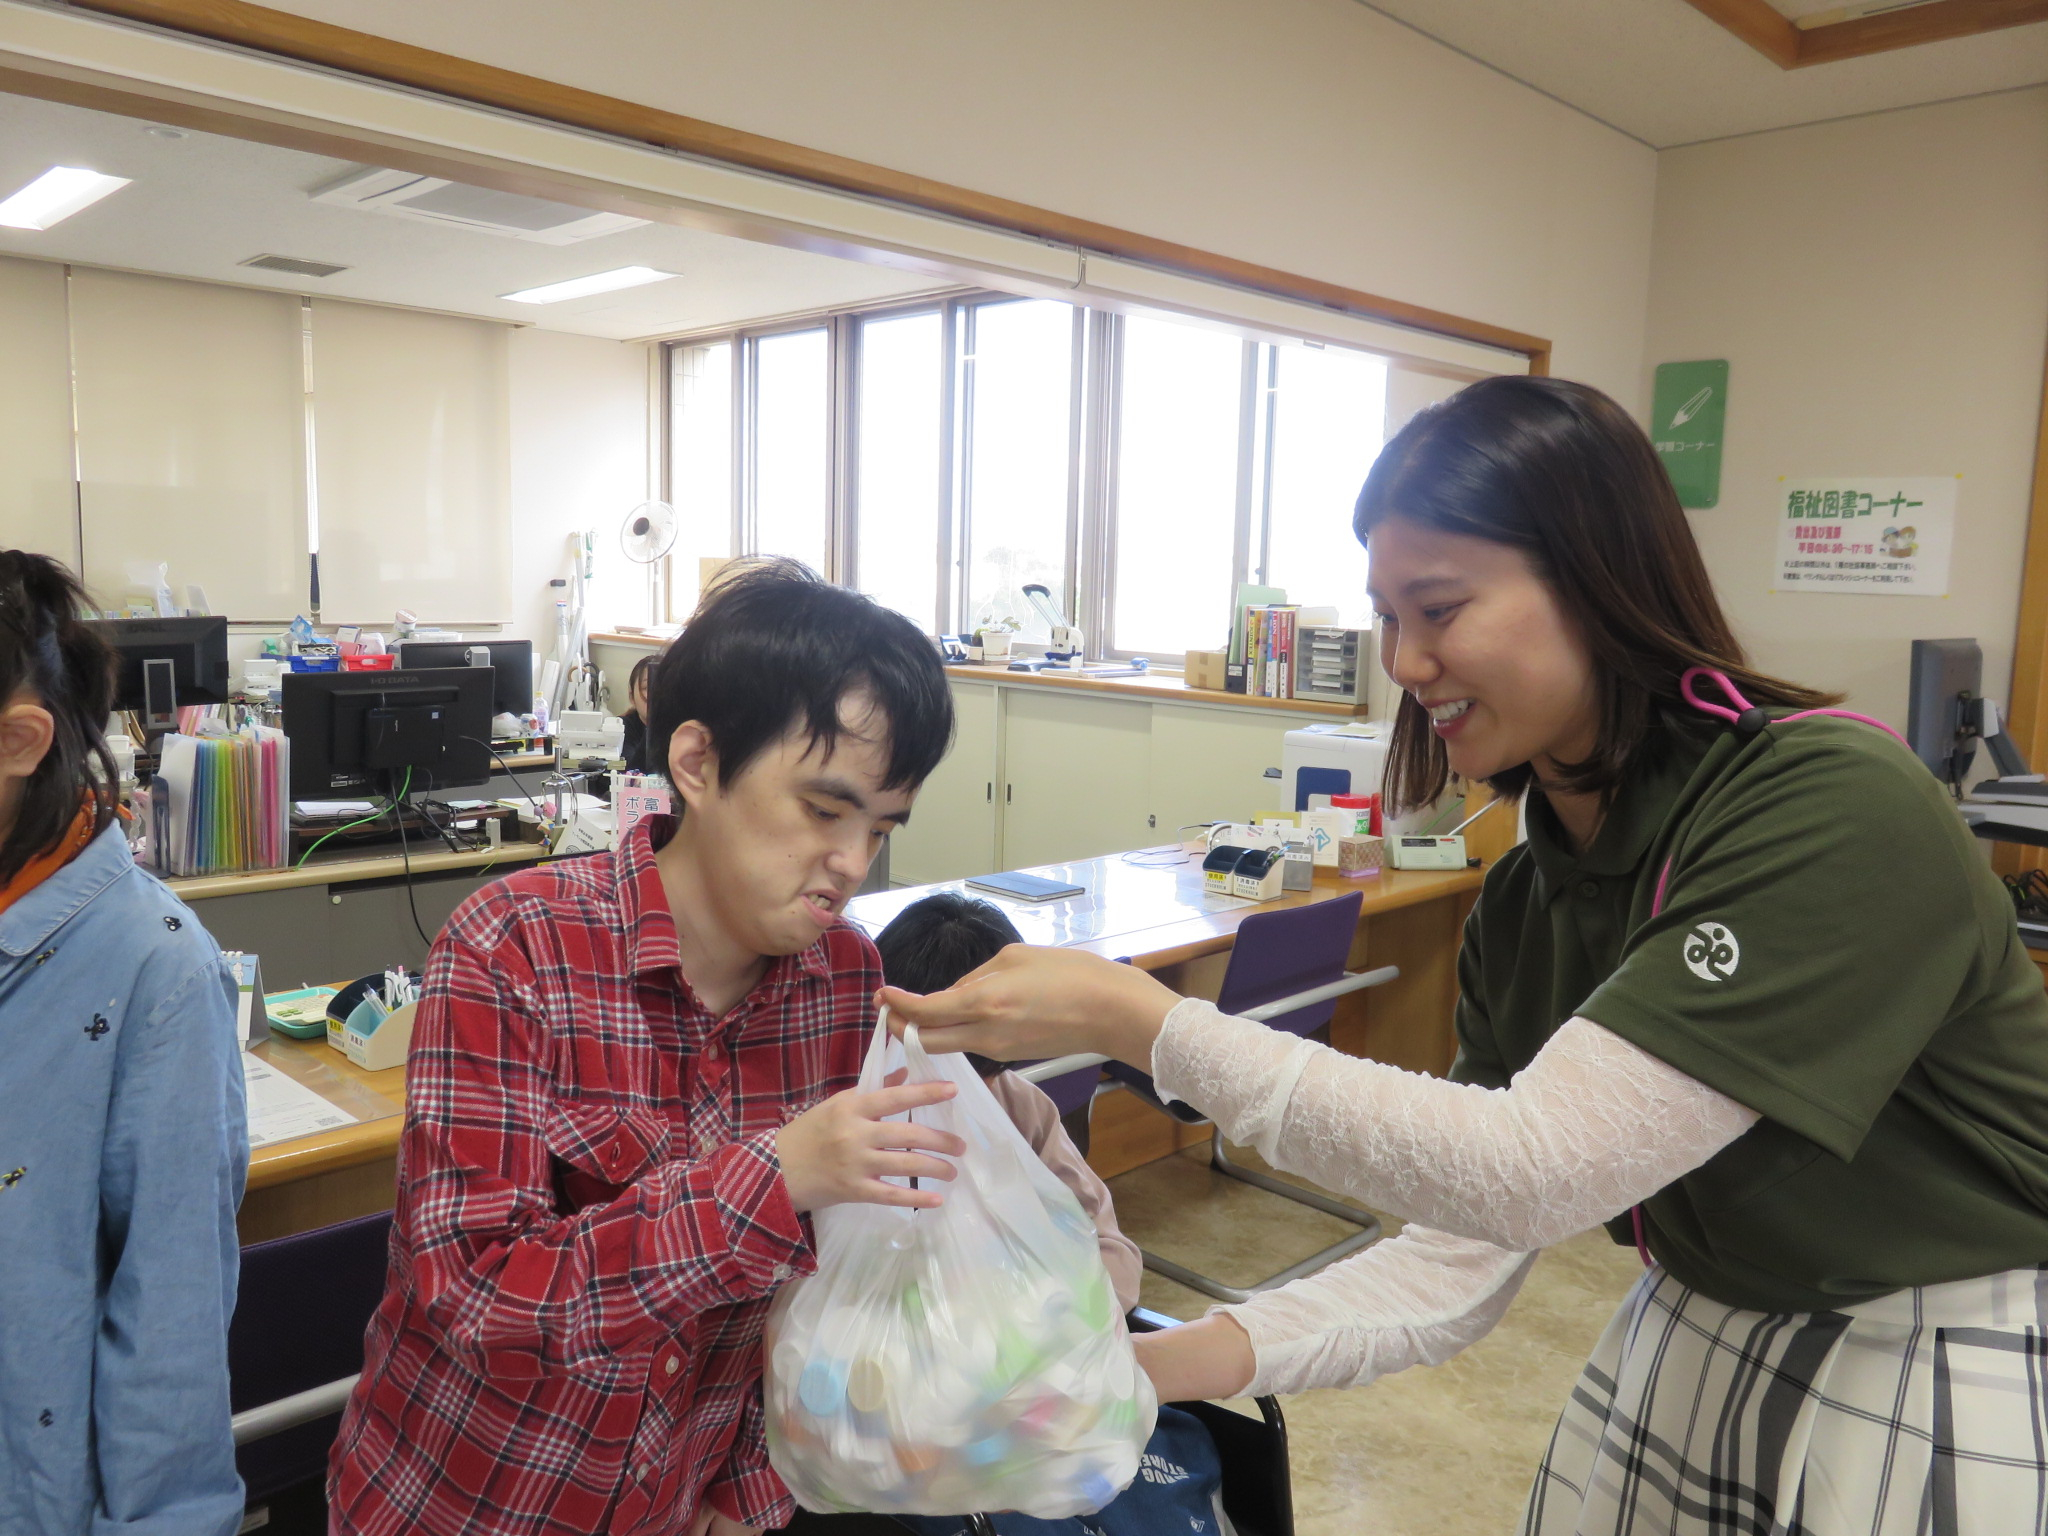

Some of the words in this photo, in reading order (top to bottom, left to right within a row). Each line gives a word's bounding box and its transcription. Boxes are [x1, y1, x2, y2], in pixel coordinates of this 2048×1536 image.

[1787, 490, 1923, 519] 福祉図書コーナー
